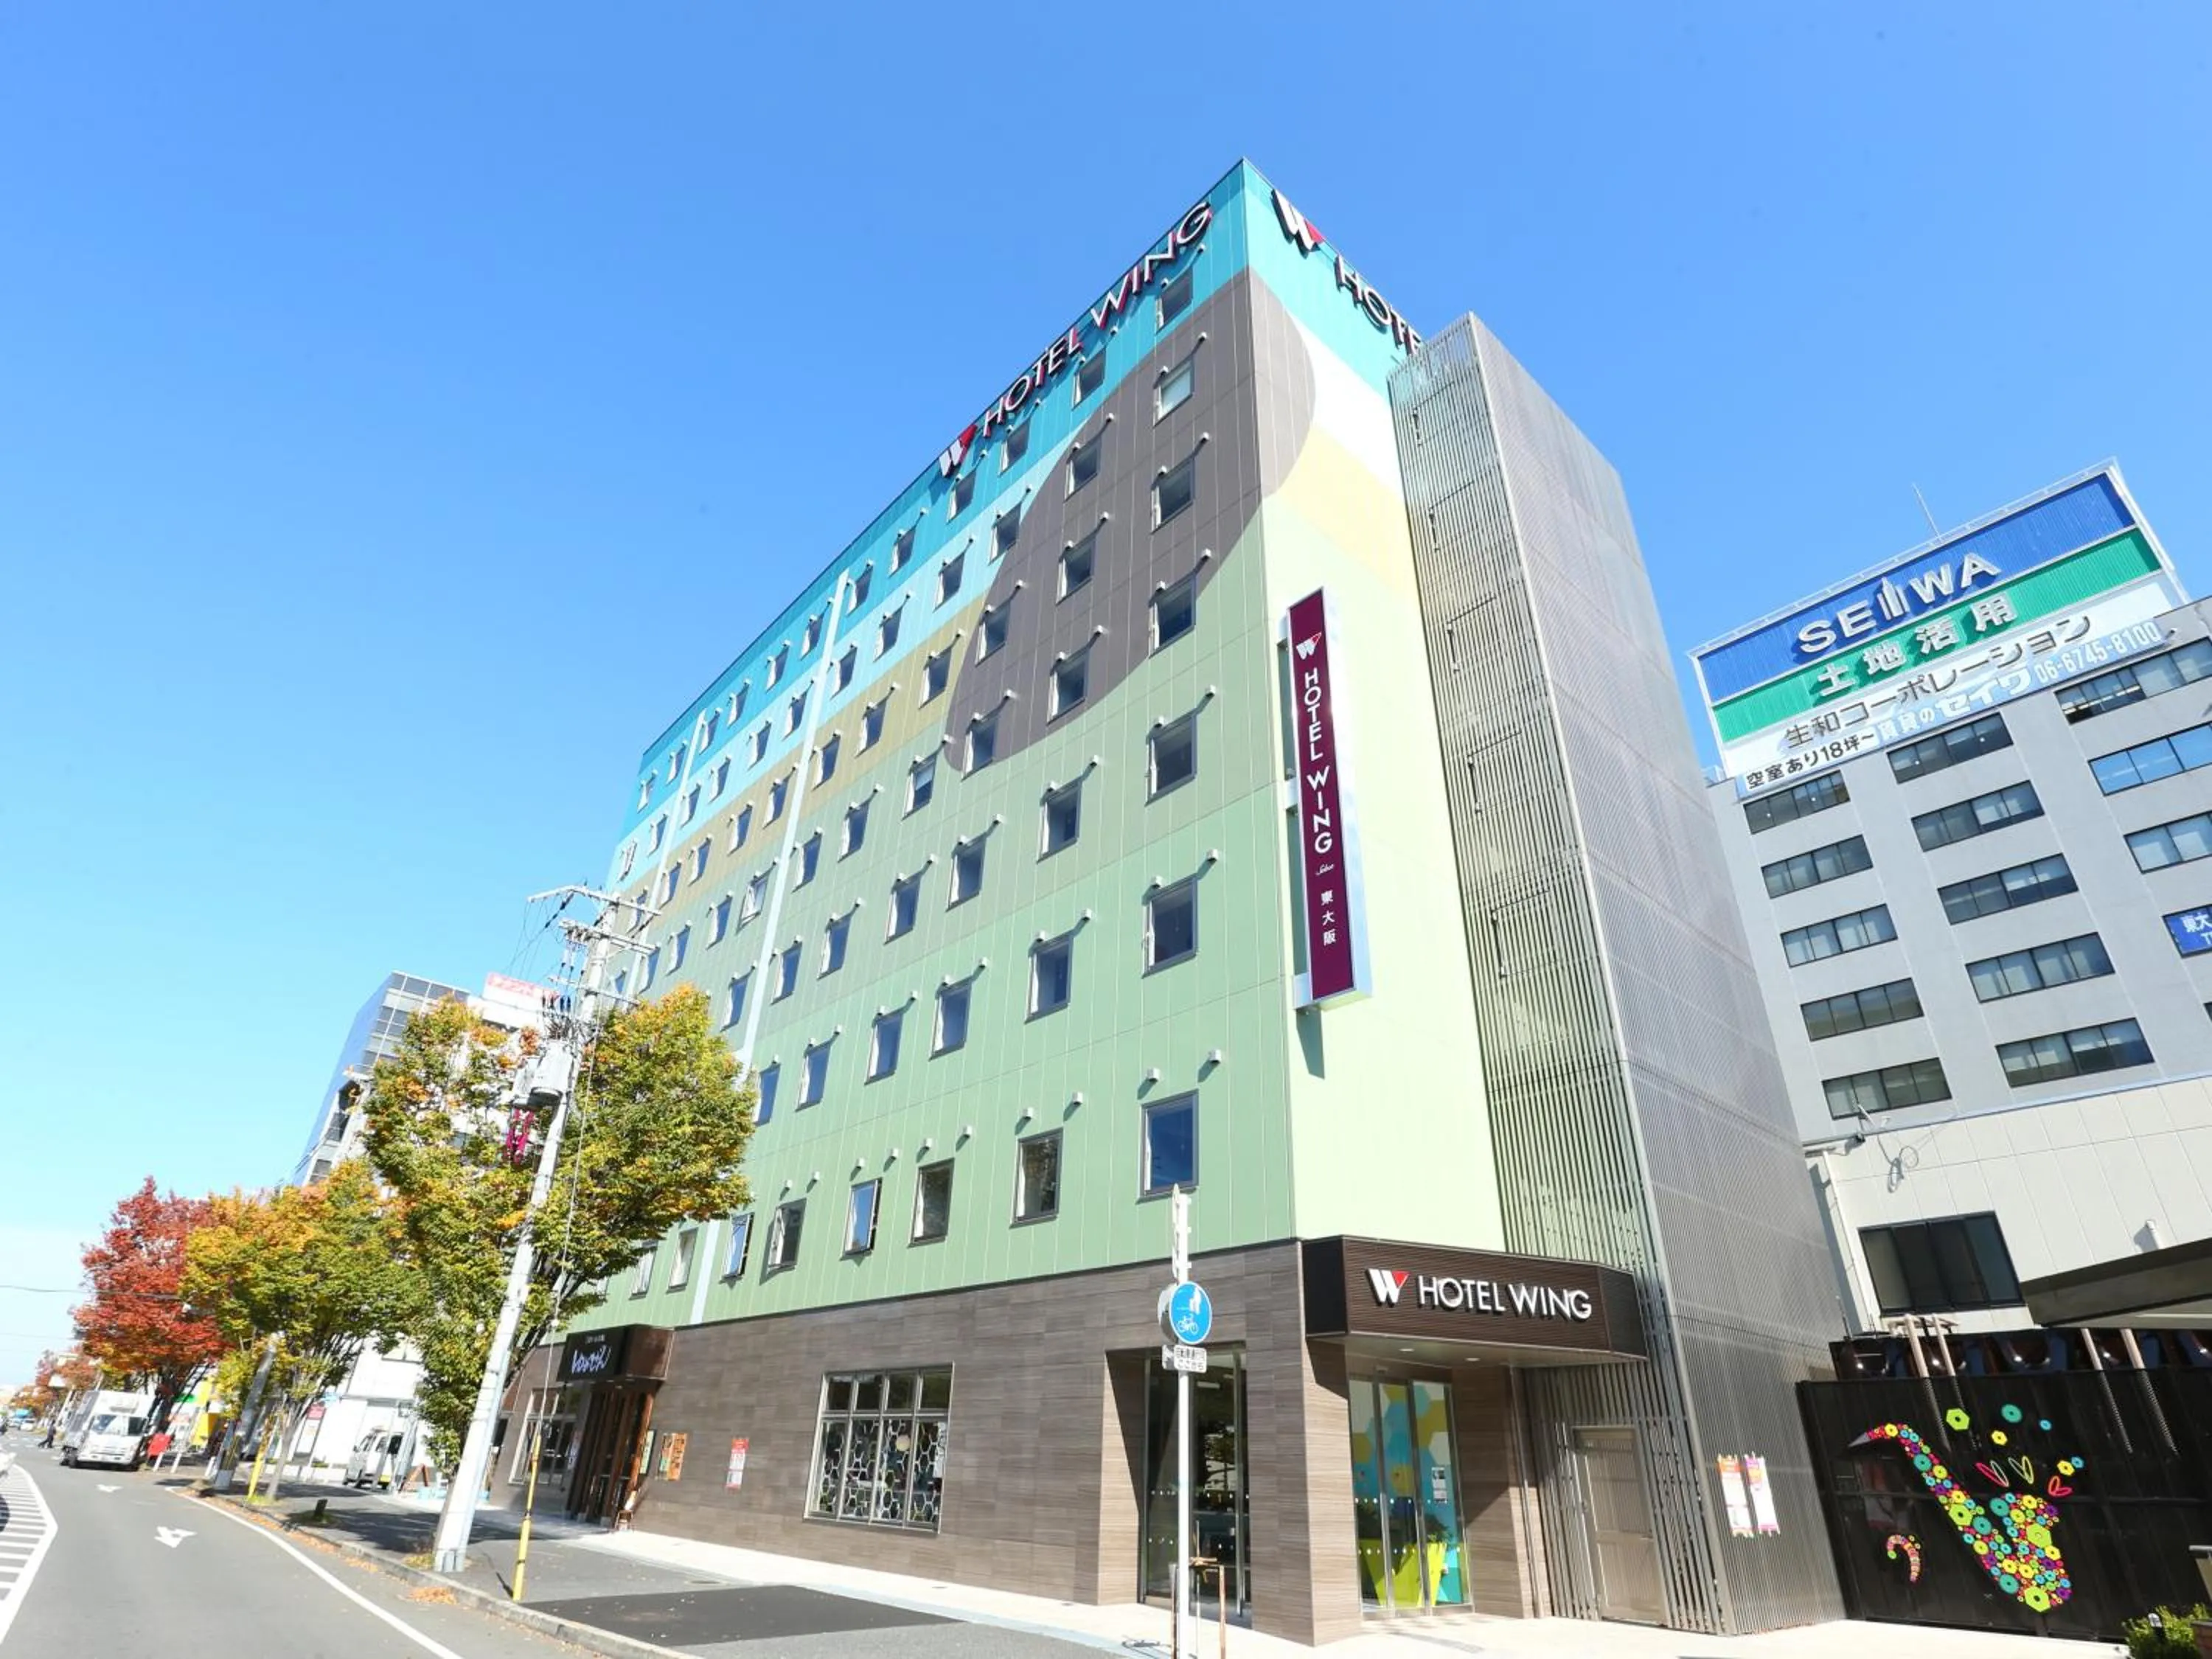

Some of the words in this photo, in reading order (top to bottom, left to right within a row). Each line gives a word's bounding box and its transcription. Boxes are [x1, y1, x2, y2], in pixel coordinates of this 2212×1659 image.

[983, 327, 1084, 437] HOTEL
[1091, 201, 1213, 330] WING
[1798, 553, 2001, 653] SEIWA
[1817, 591, 2017, 697] 土地活用
[1784, 616, 2091, 749] 生和コーポレーション
[2034, 621, 2163, 684] 06-6745-8100
[1304, 667, 1324, 761] HOTEL
[1307, 764, 1333, 854] WING
[1321, 889, 1337, 947] 東大阪
[1419, 1275, 1506, 1312] HOTEL
[1508, 1283, 1593, 1320] WING
